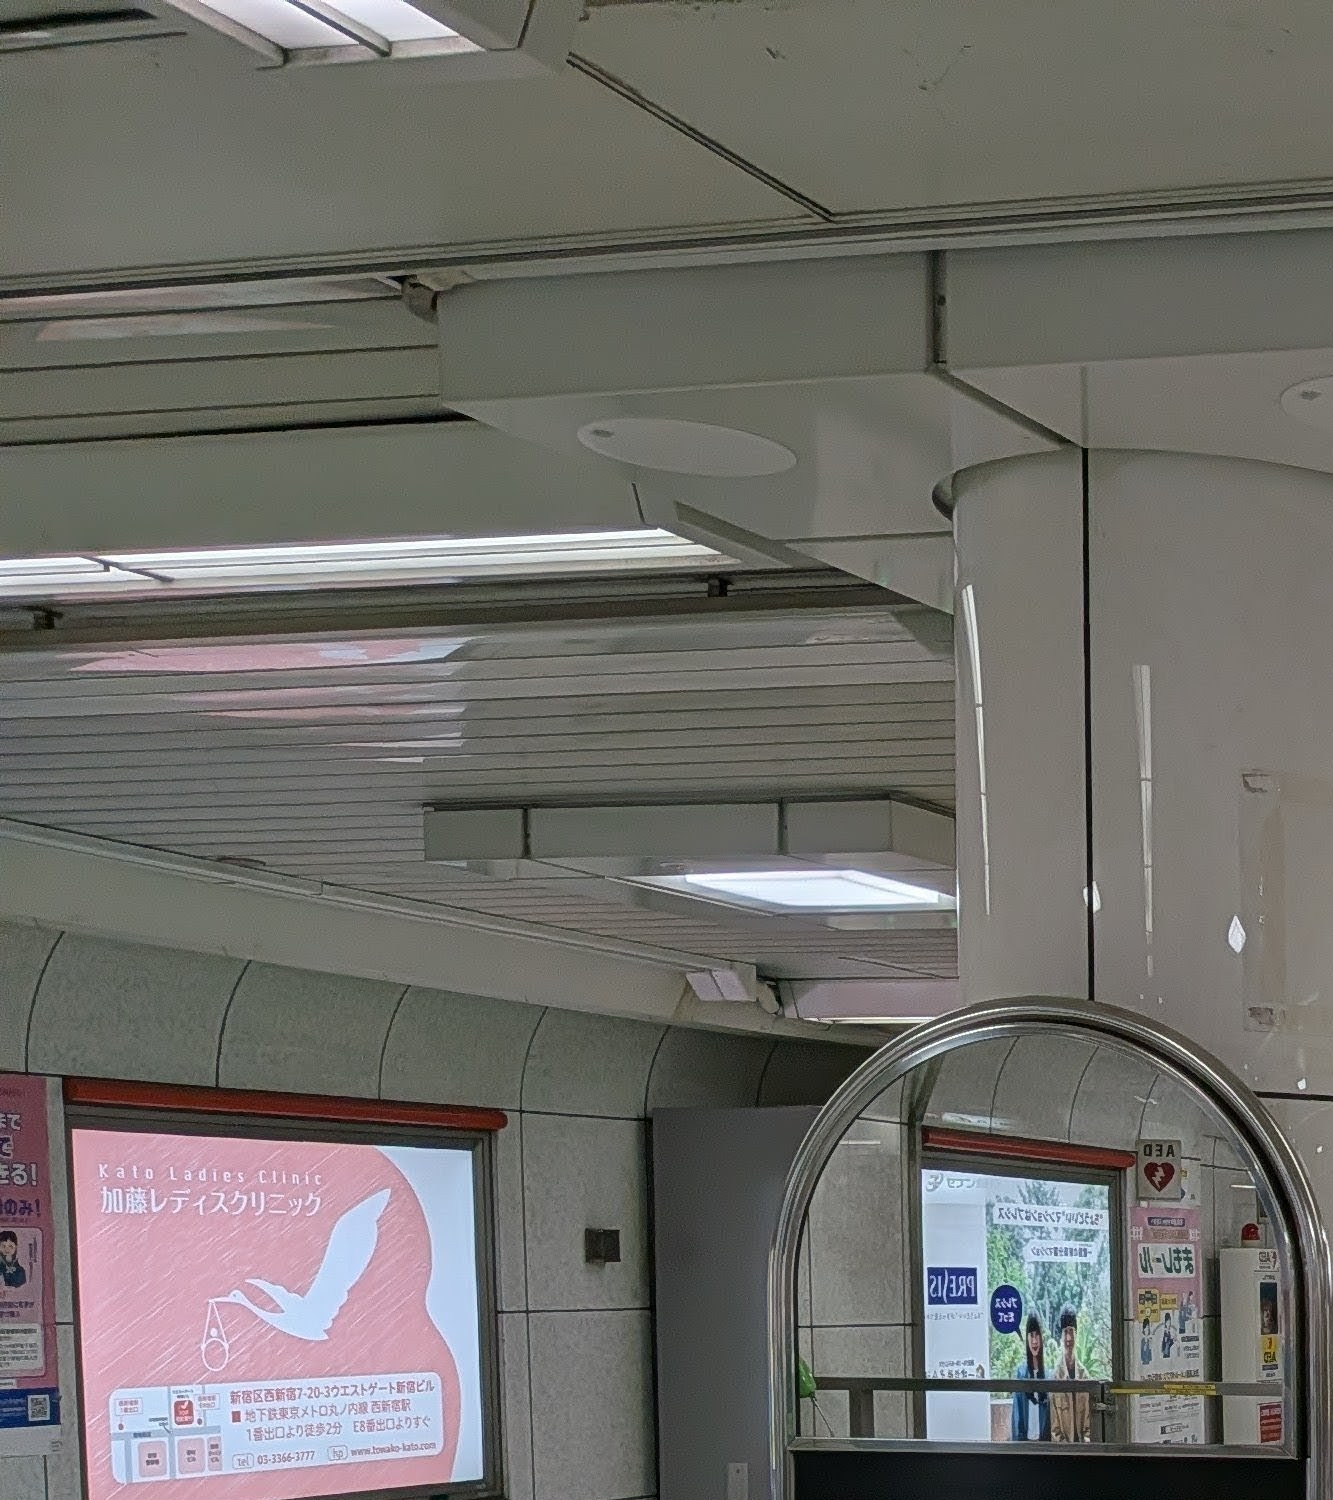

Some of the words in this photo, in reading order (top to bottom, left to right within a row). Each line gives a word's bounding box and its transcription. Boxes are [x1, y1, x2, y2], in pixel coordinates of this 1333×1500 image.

[98, 1163, 153, 1180] Kato
[169, 1166, 244, 1183] Ladies
[259, 1169, 322, 1186] Clinic
[0, 1198, 41, 1218] のみ!
[100, 1186, 321, 1217] 加藤レディスクリニック
[245, 1401, 369, 1423] 地下鉄東京メトロ丸ノ内線
[371, 1398, 412, 1414] 西新宿駅
[246, 1422, 343, 1442] 1番出口より徒歩2分
[353, 1416, 431, 1433] E8番出口よりすぐ
[257, 1451, 315, 1465] 03-3366-3777
